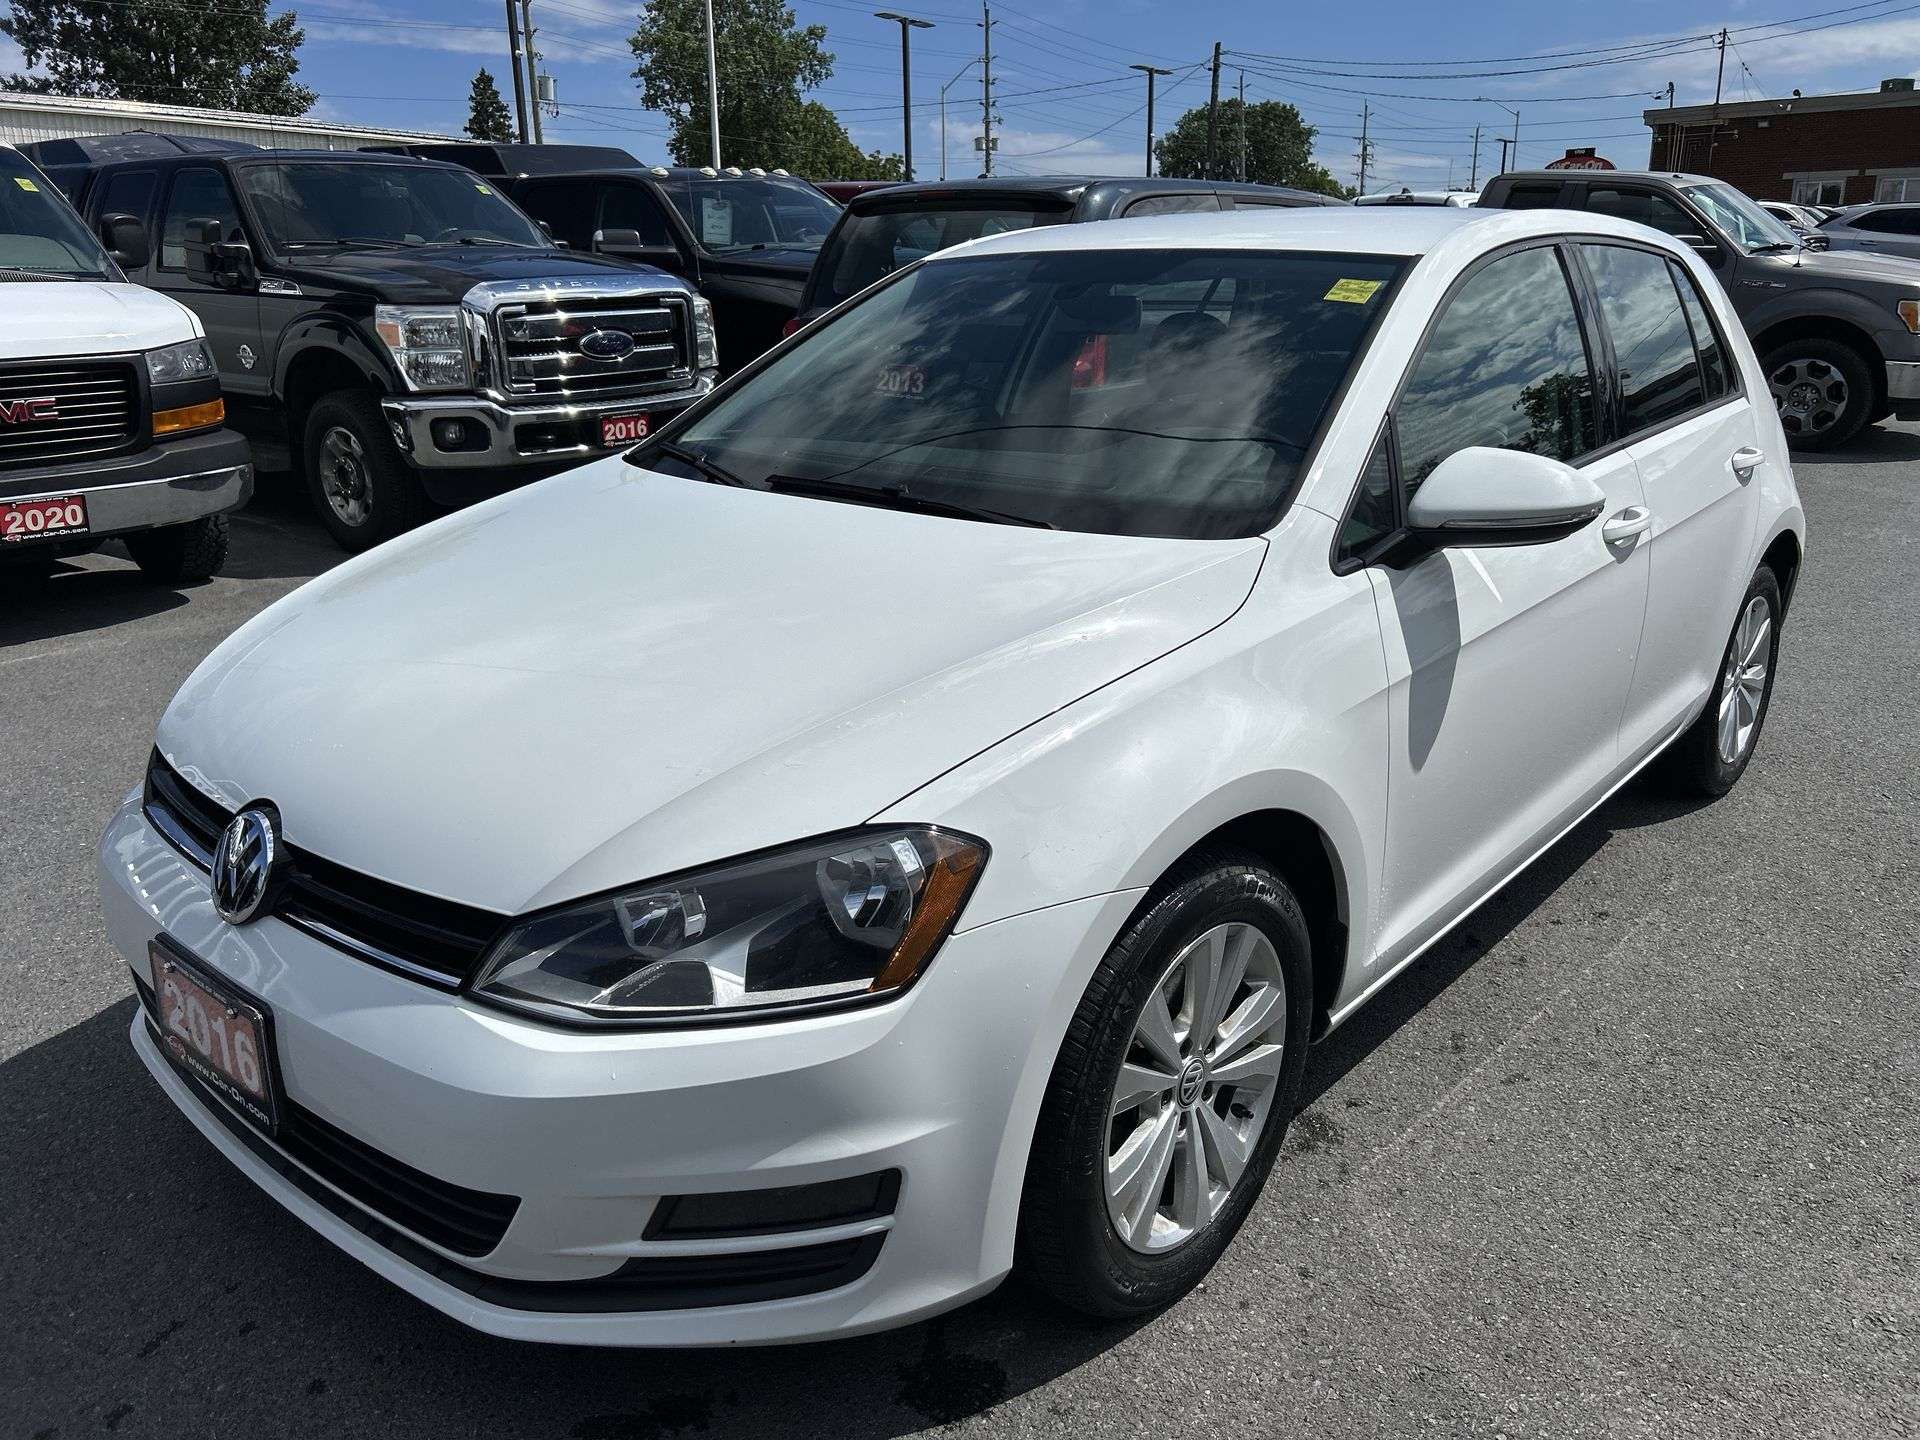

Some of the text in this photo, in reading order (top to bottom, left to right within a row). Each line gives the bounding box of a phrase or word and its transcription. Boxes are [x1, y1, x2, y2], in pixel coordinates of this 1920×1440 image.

[876, 369, 925, 393] 2013
[604, 419, 648, 441] 2016
[5, 504, 84, 534] 2020
[22, 527, 88, 541] www.Car-On.com
[164, 979, 261, 1092] 2016
[187, 1054, 270, 1126] www.Car-On.com
